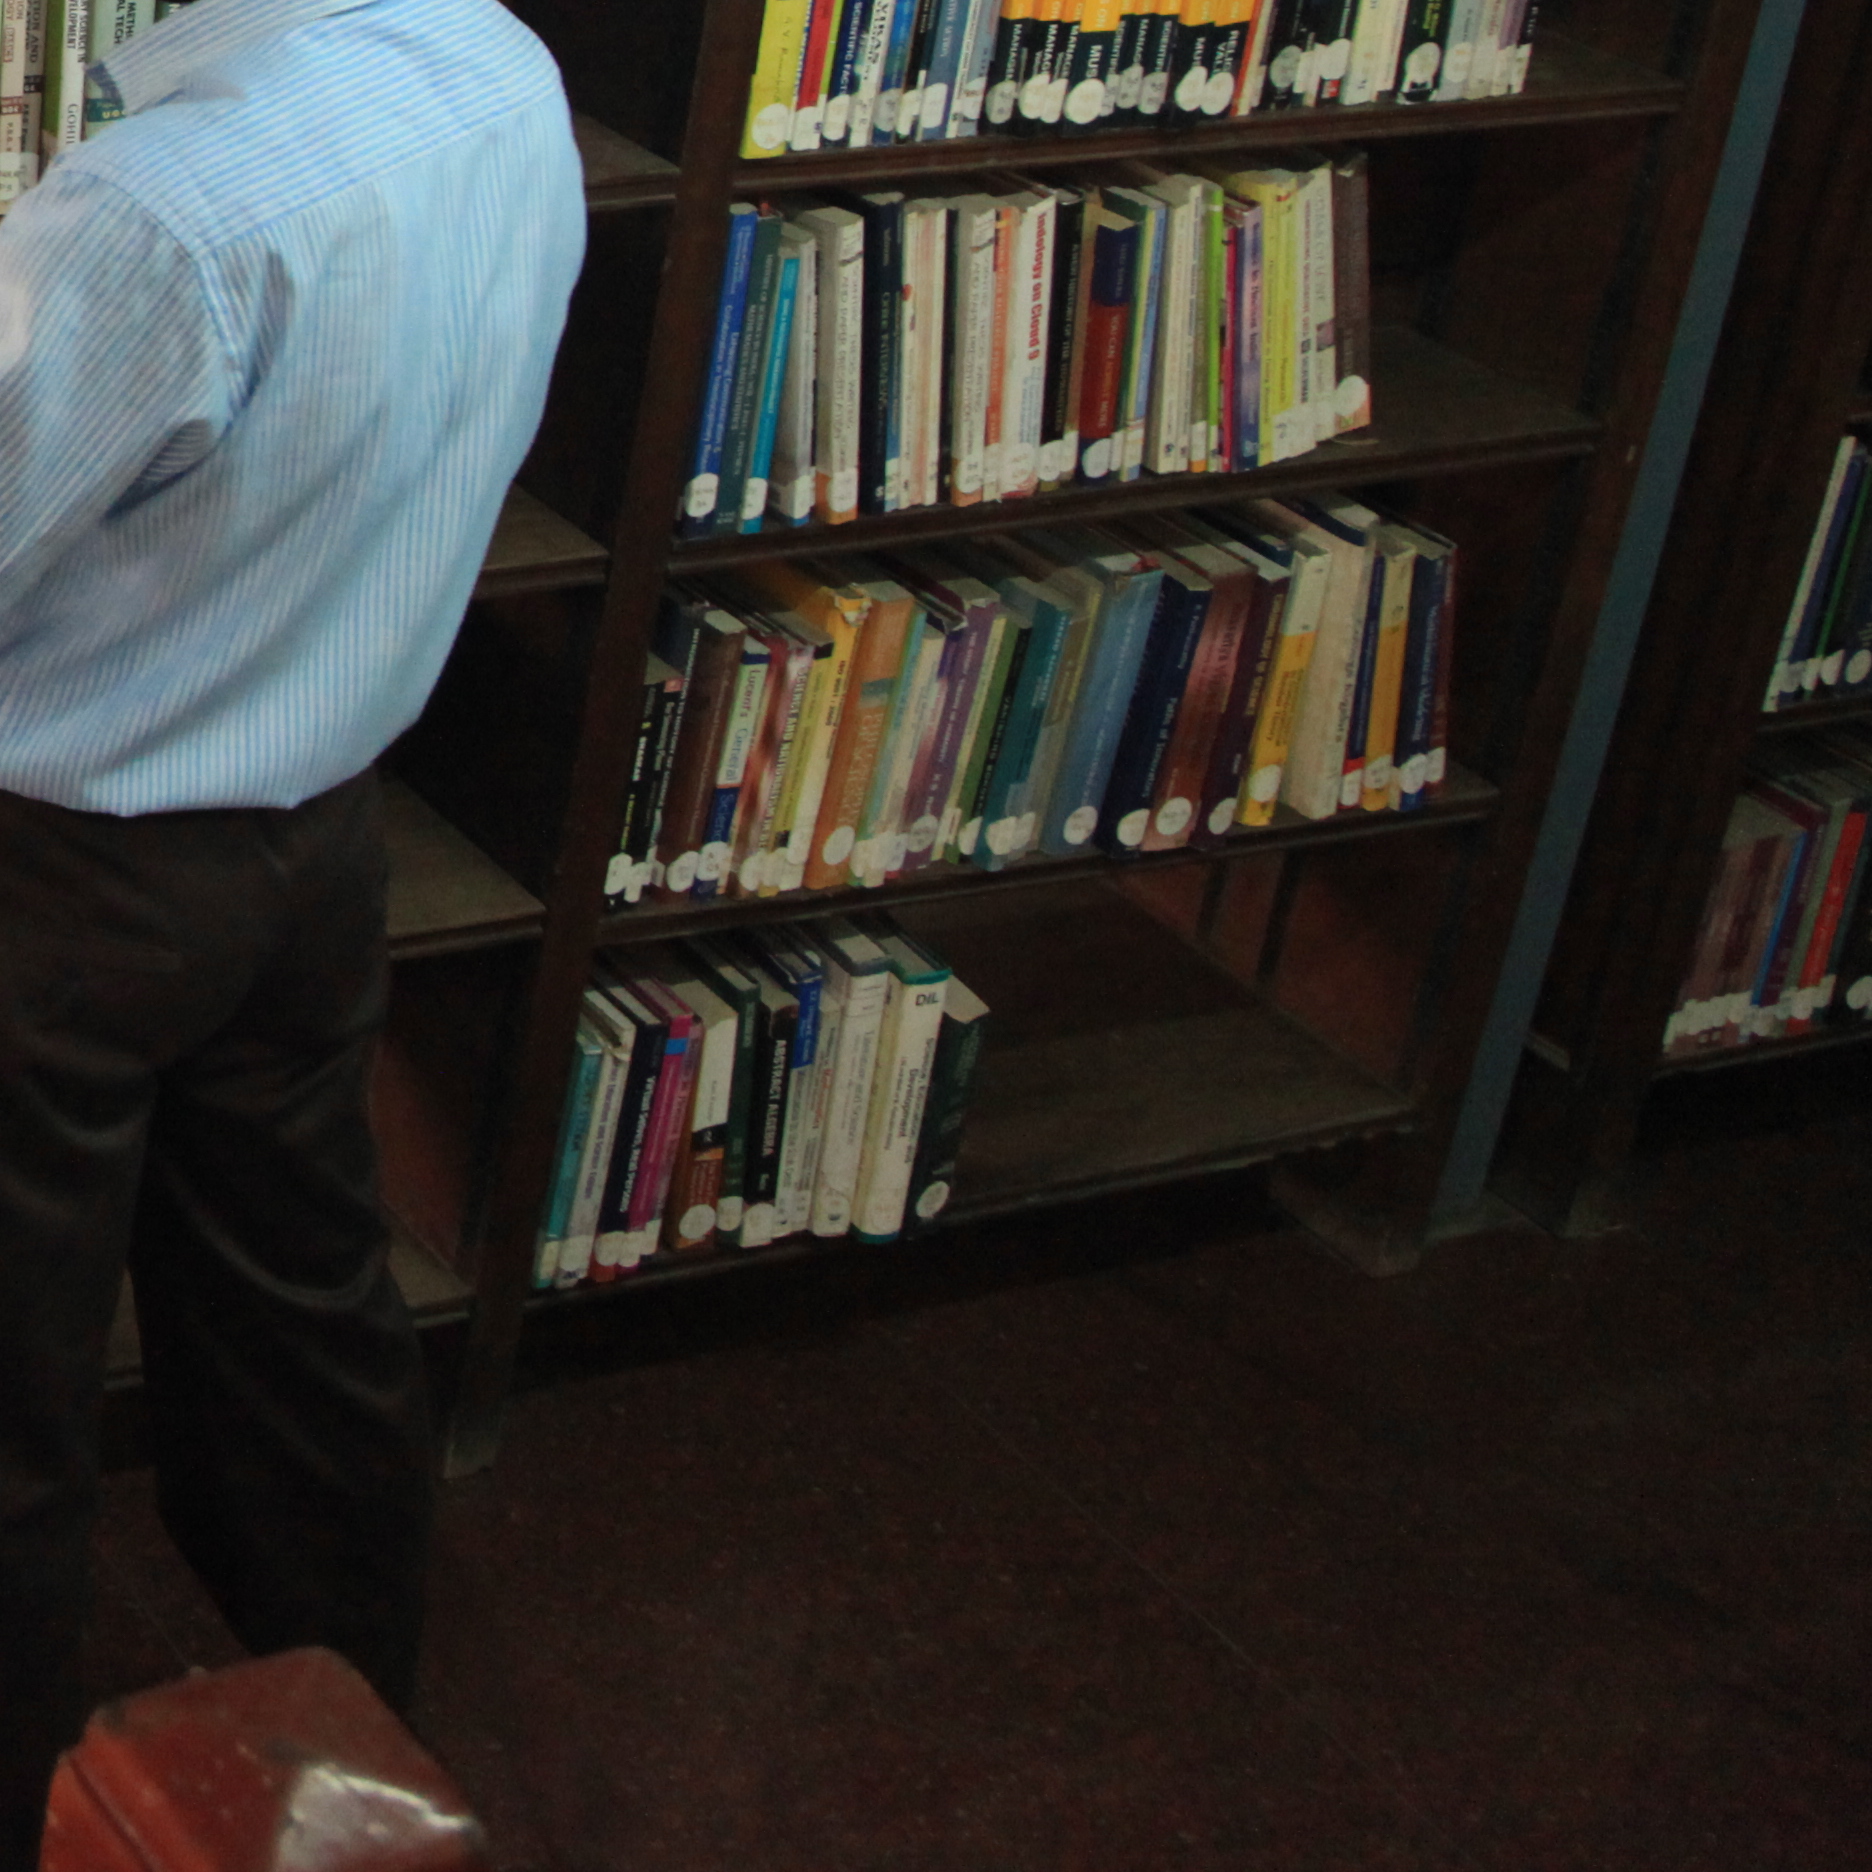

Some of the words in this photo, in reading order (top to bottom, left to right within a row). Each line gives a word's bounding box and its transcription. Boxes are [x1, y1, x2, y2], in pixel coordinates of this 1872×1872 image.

[1032, 283, 1040, 301] on
[1029, 305, 1041, 345] Cloud
[1028, 349, 1039, 359] 9
[916, 992, 939, 1006] DIL
[768, 1040, 786, 1099] ABSTRACT
[762, 1105, 779, 1156] ALGEBRA
